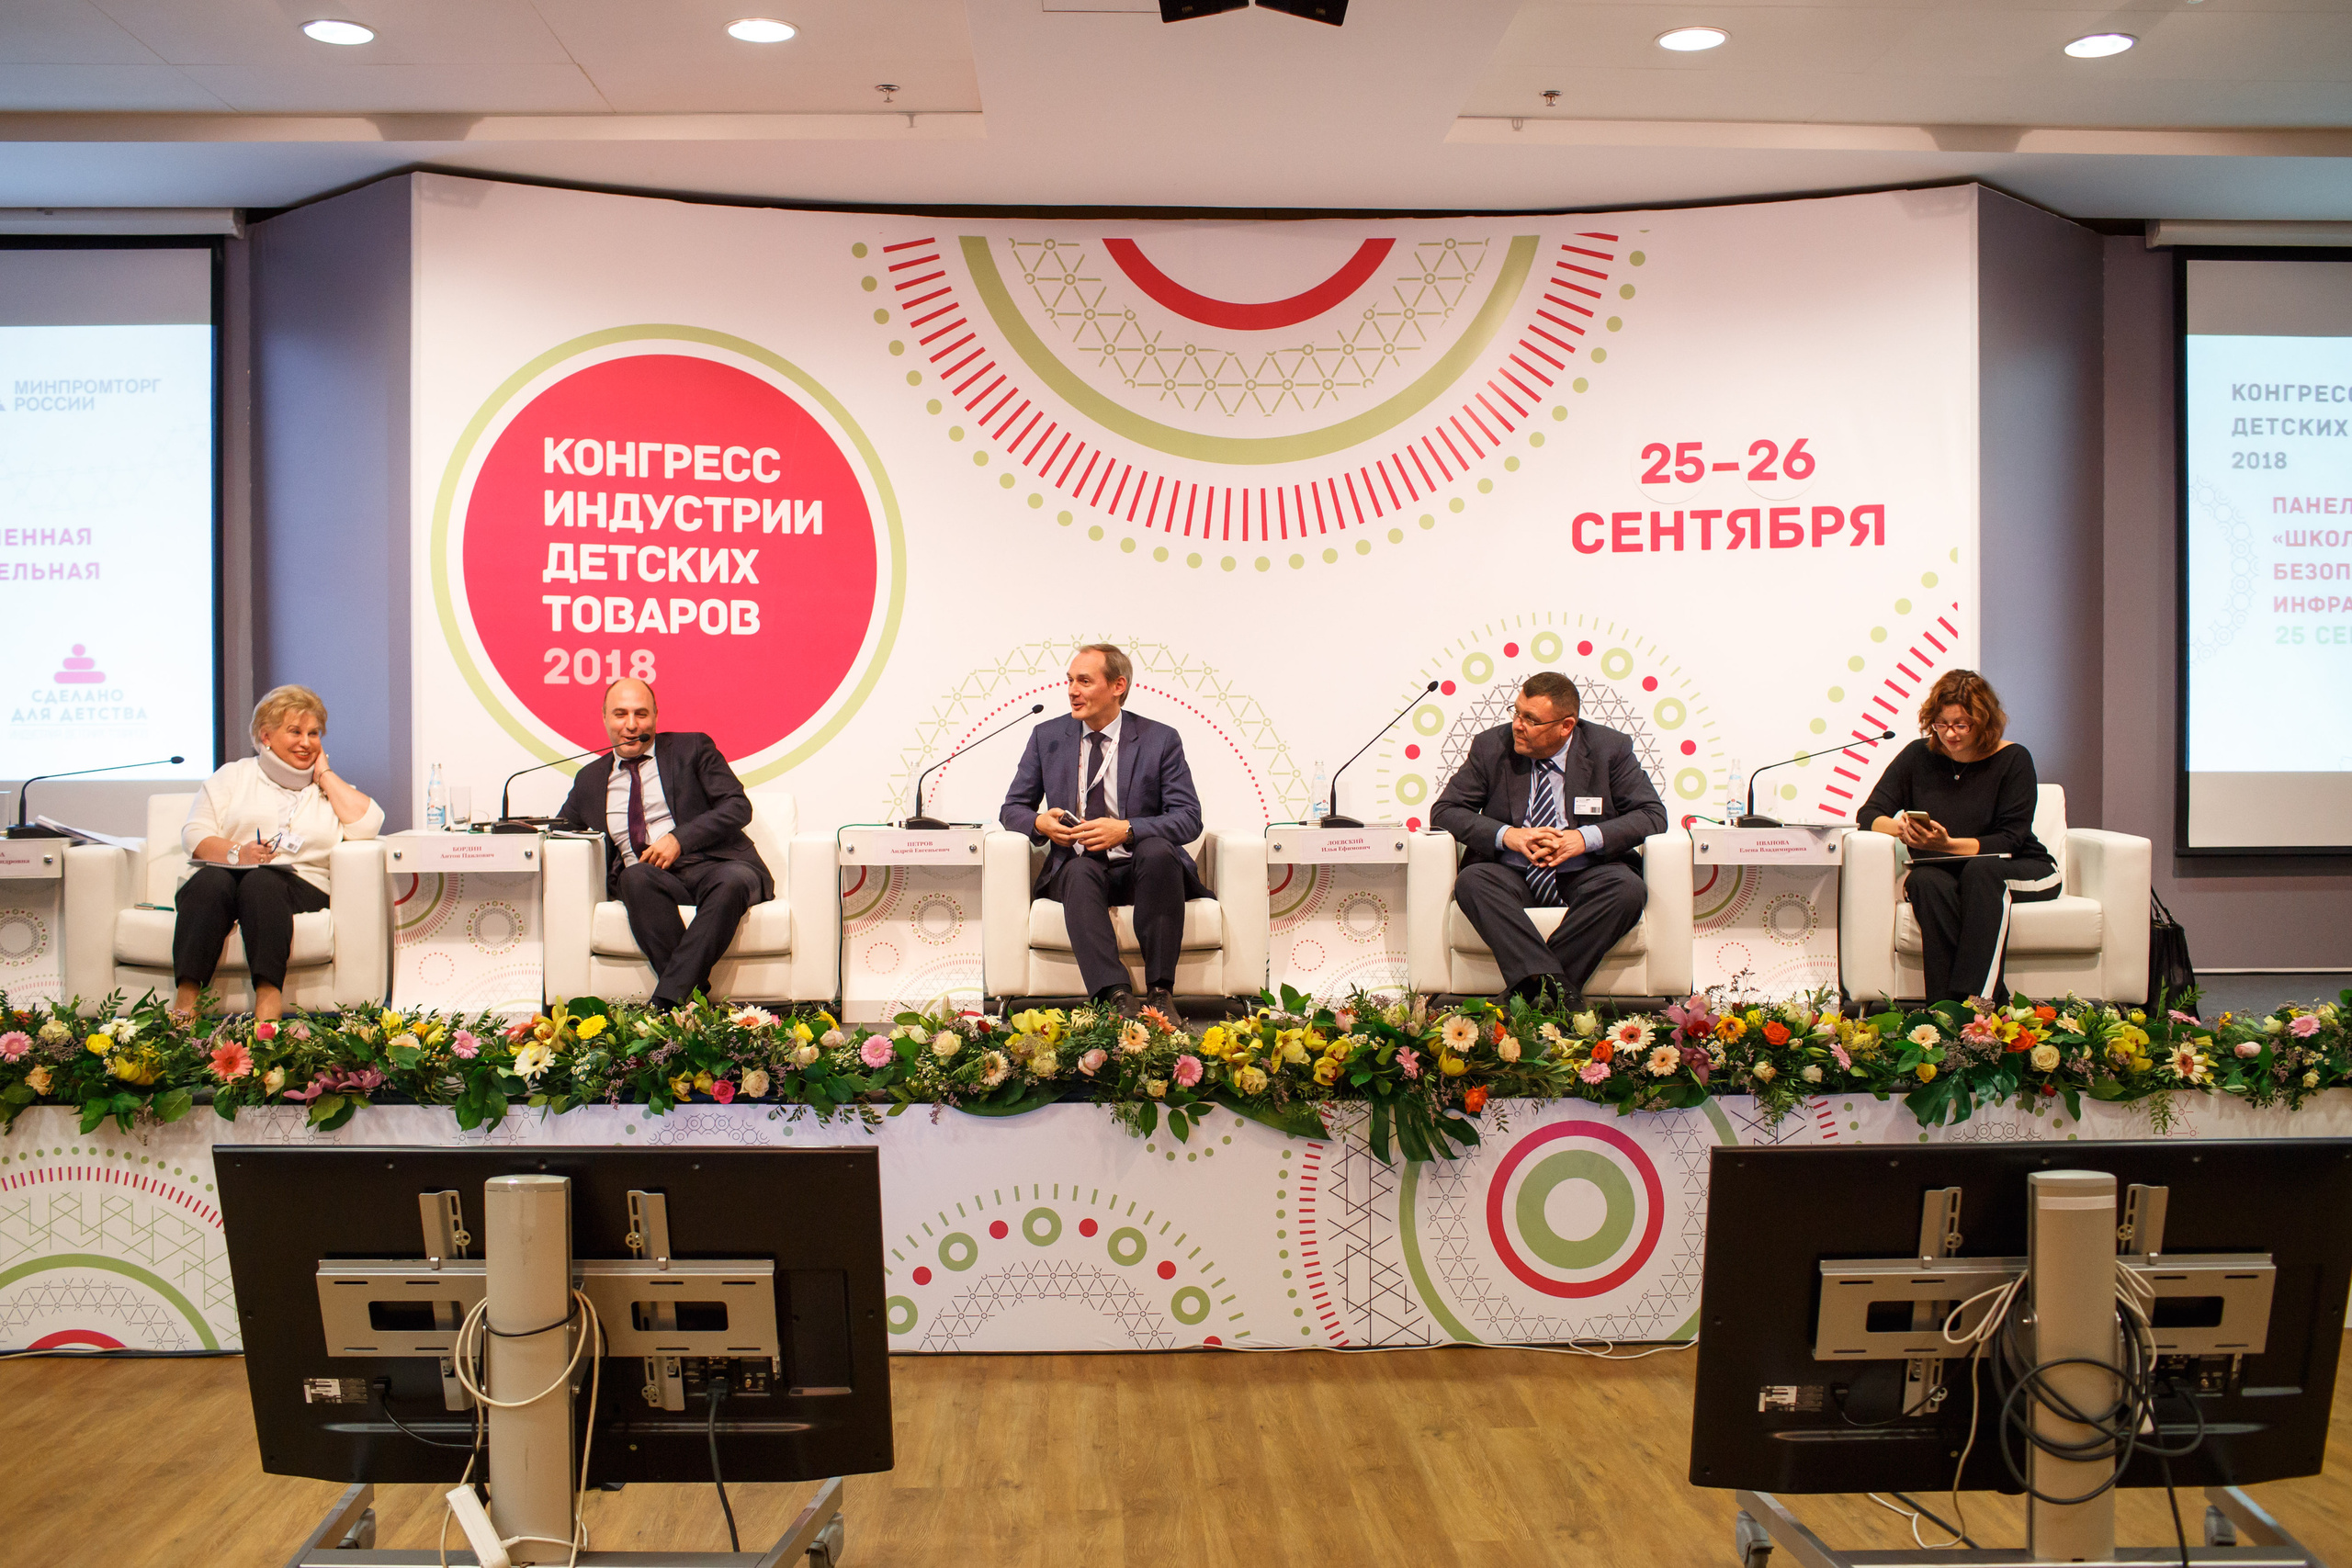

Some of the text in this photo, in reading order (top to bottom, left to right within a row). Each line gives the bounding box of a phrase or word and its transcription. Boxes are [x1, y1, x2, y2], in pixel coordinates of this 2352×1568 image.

[14, 378, 162, 396] МИНПРОМТОРГ
[2232, 383, 2352, 403] КОНГРЕС
[14, 396, 96, 412] РОССИИ
[2232, 417, 2348, 437] ДЕТСКИХ
[544, 436, 781, 483] КОНГРЕСС
[2232, 451, 2288, 469] 2018
[544, 490, 823, 535] ИНДУСТРИИ
[2273, 496, 2352, 514] ПАНЕЛ
[0, 527, 92, 546] ЕННАЯ
[1571, 504, 1885, 555] СЕНТЯБРЯ
[542, 542, 760, 584] ДЕТСКИХ
[2273, 595, 2352, 614] ИНФРА
[542, 594, 761, 636] ТОВАРОВ
[2276, 626, 2352, 645] 25 СЕ
[543, 648, 657, 685] 2018
[31, 688, 124, 705] СДЕЛАНО
[11, 706, 148, 722] ДЛЯ ДЕТСТВА
[889, 847, 913, 855] Андрей
[1327, 838, 1364, 846] ЛОЕВСКИЙ
